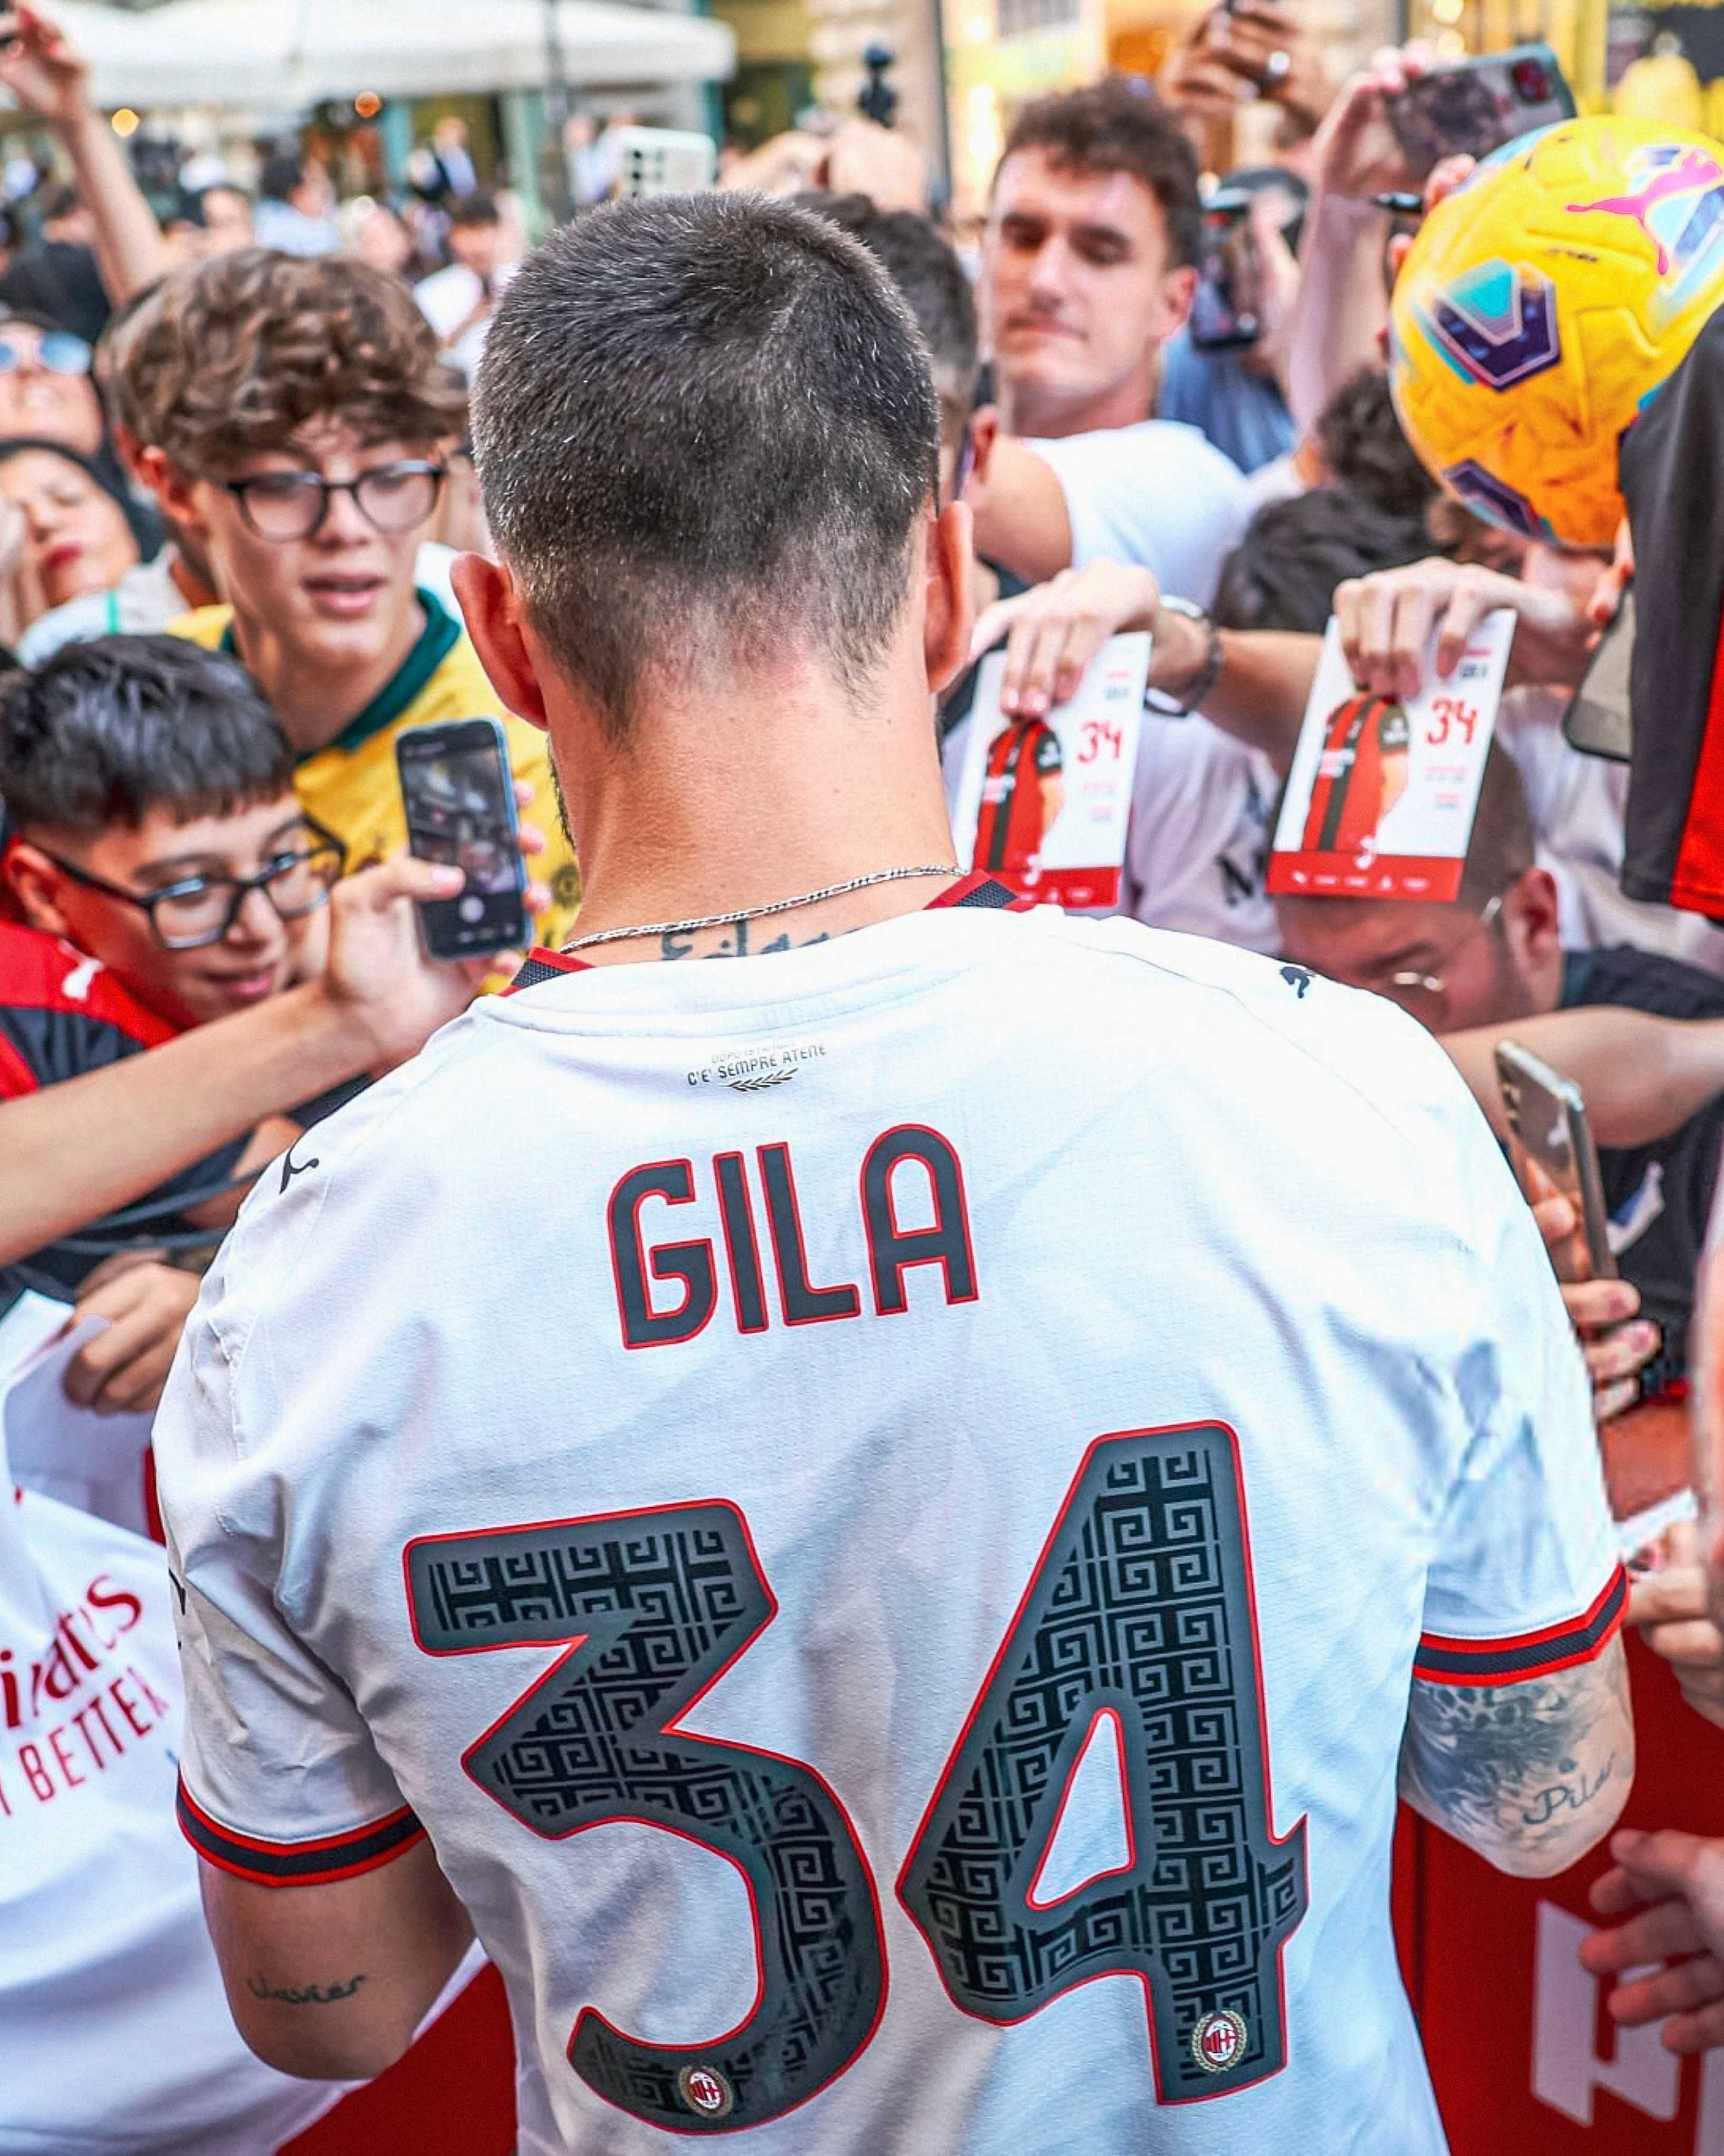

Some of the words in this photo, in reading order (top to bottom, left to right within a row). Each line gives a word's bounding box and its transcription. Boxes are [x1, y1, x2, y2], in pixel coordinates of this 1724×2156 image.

[1077, 720, 1123, 764] 34
[1425, 695, 1478, 746] 34
[717, 1056, 777, 1079] SEMPRE
[783, 1044, 827, 1064] ATENE
[607, 1123, 980, 1350] GILA
[402, 1419, 1308, 2136] 34
